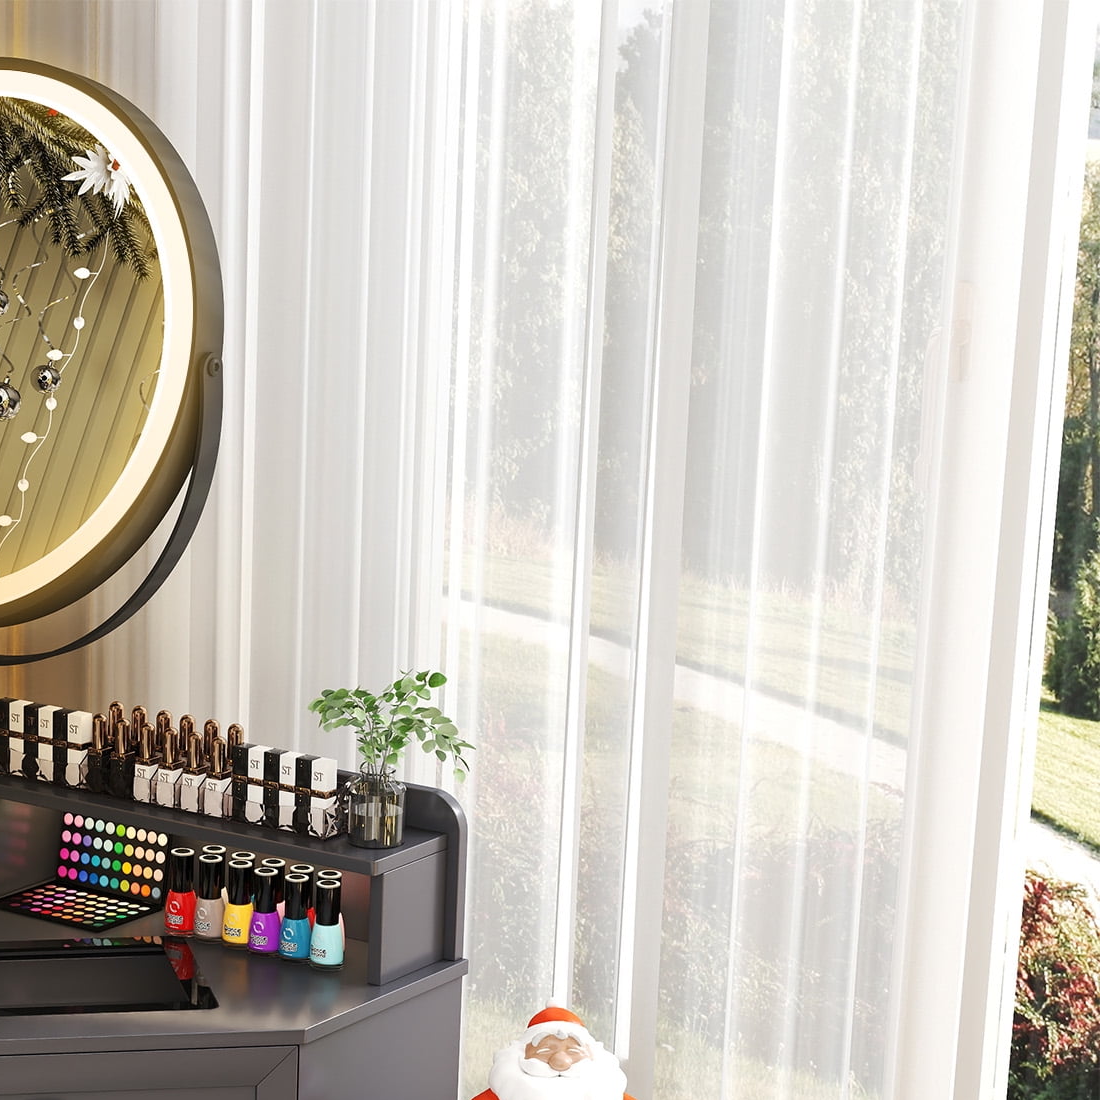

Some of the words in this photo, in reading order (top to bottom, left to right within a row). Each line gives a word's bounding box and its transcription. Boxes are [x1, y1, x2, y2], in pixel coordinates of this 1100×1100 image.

[11, 713, 21, 723] ST
[40, 719, 50, 729] ST
[69, 724, 79, 734] ST
[250, 760, 260, 769] ST
[137, 768, 147, 777] ST
[282, 766, 292, 775] ST
[160, 773, 170, 782] ST
[314, 772, 324, 782] ST
[184, 777, 194, 787] ST
[208, 782, 218, 791] ST
